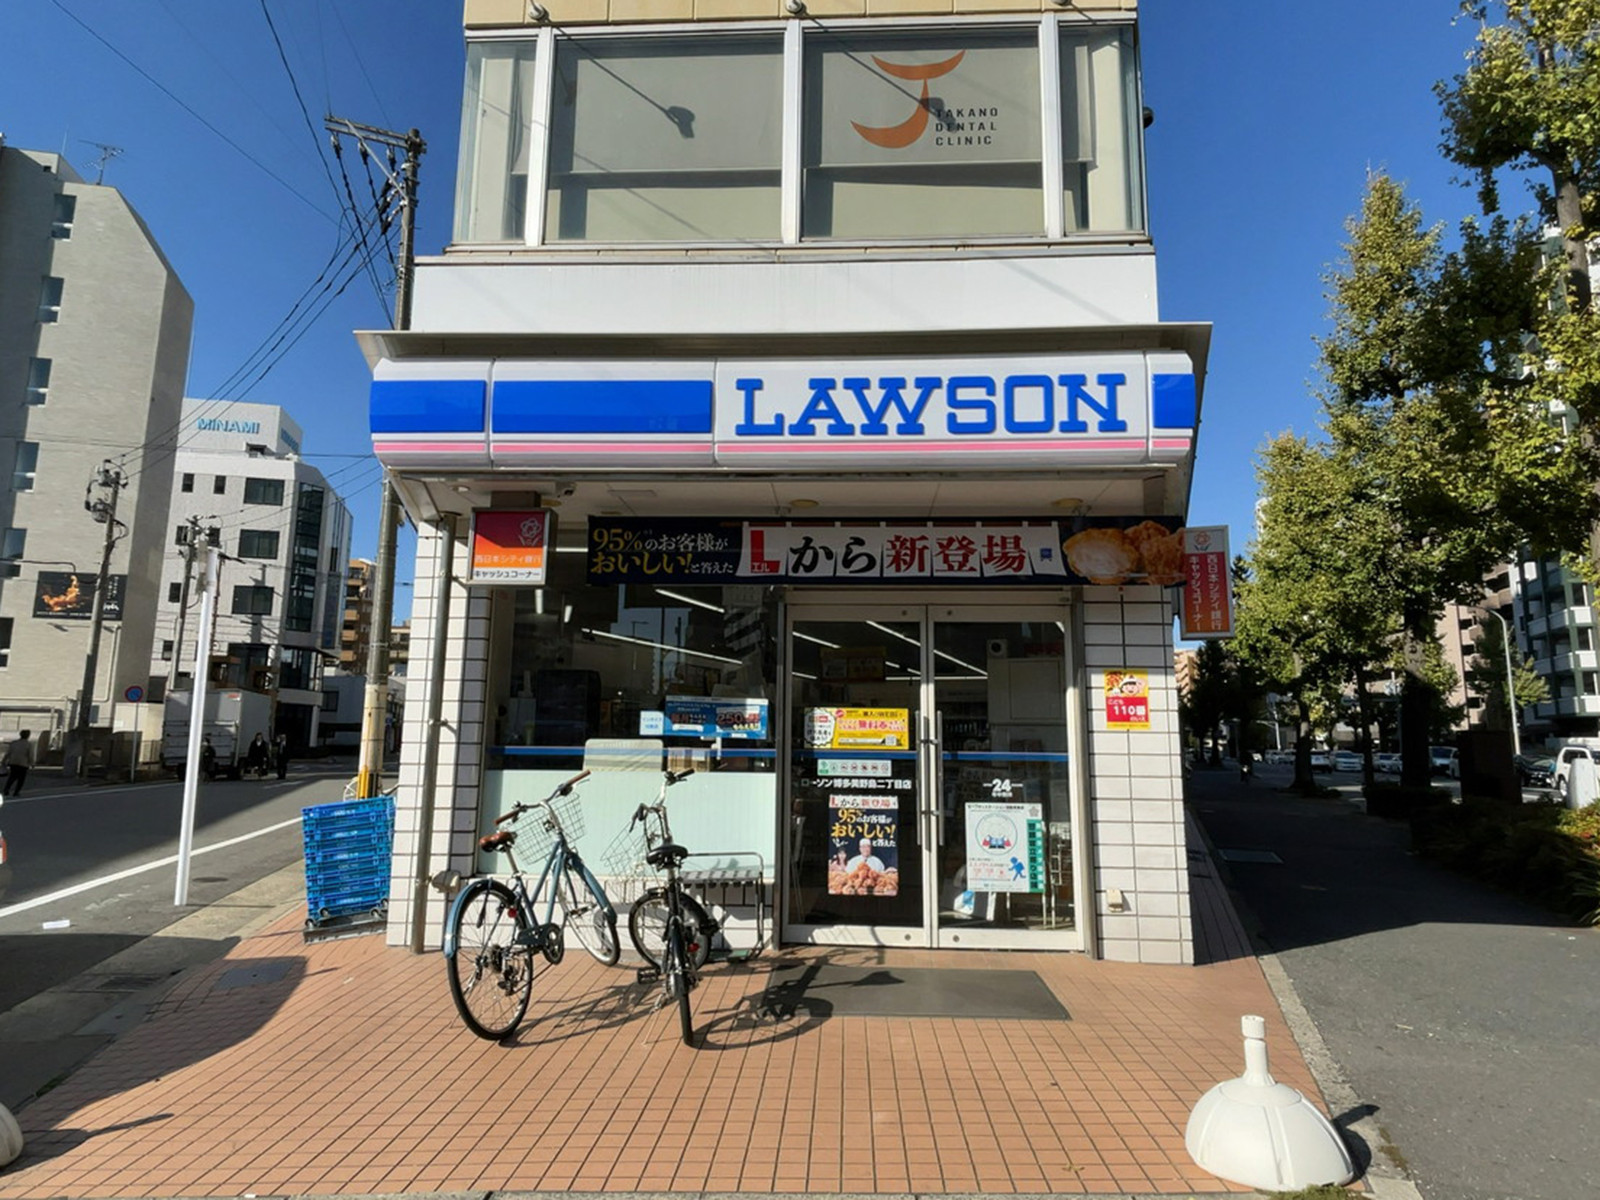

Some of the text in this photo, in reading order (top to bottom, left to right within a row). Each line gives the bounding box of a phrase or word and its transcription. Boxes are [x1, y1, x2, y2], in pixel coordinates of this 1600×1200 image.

[936, 107, 998, 118] TAKANO
[935, 121, 997, 133] DENTAL
[935, 135, 992, 146] CLINIC
[735, 373, 1127, 436] LAWSON
[197, 418, 260, 434] MINAMI
[474, 570, 540, 578] キャッシュコーナー
[1189, 556, 1202, 631] キャッシュコーナー
[1206, 553, 1222, 630] 西日本シティ銀行
[991, 778, 1012, 792] 24
